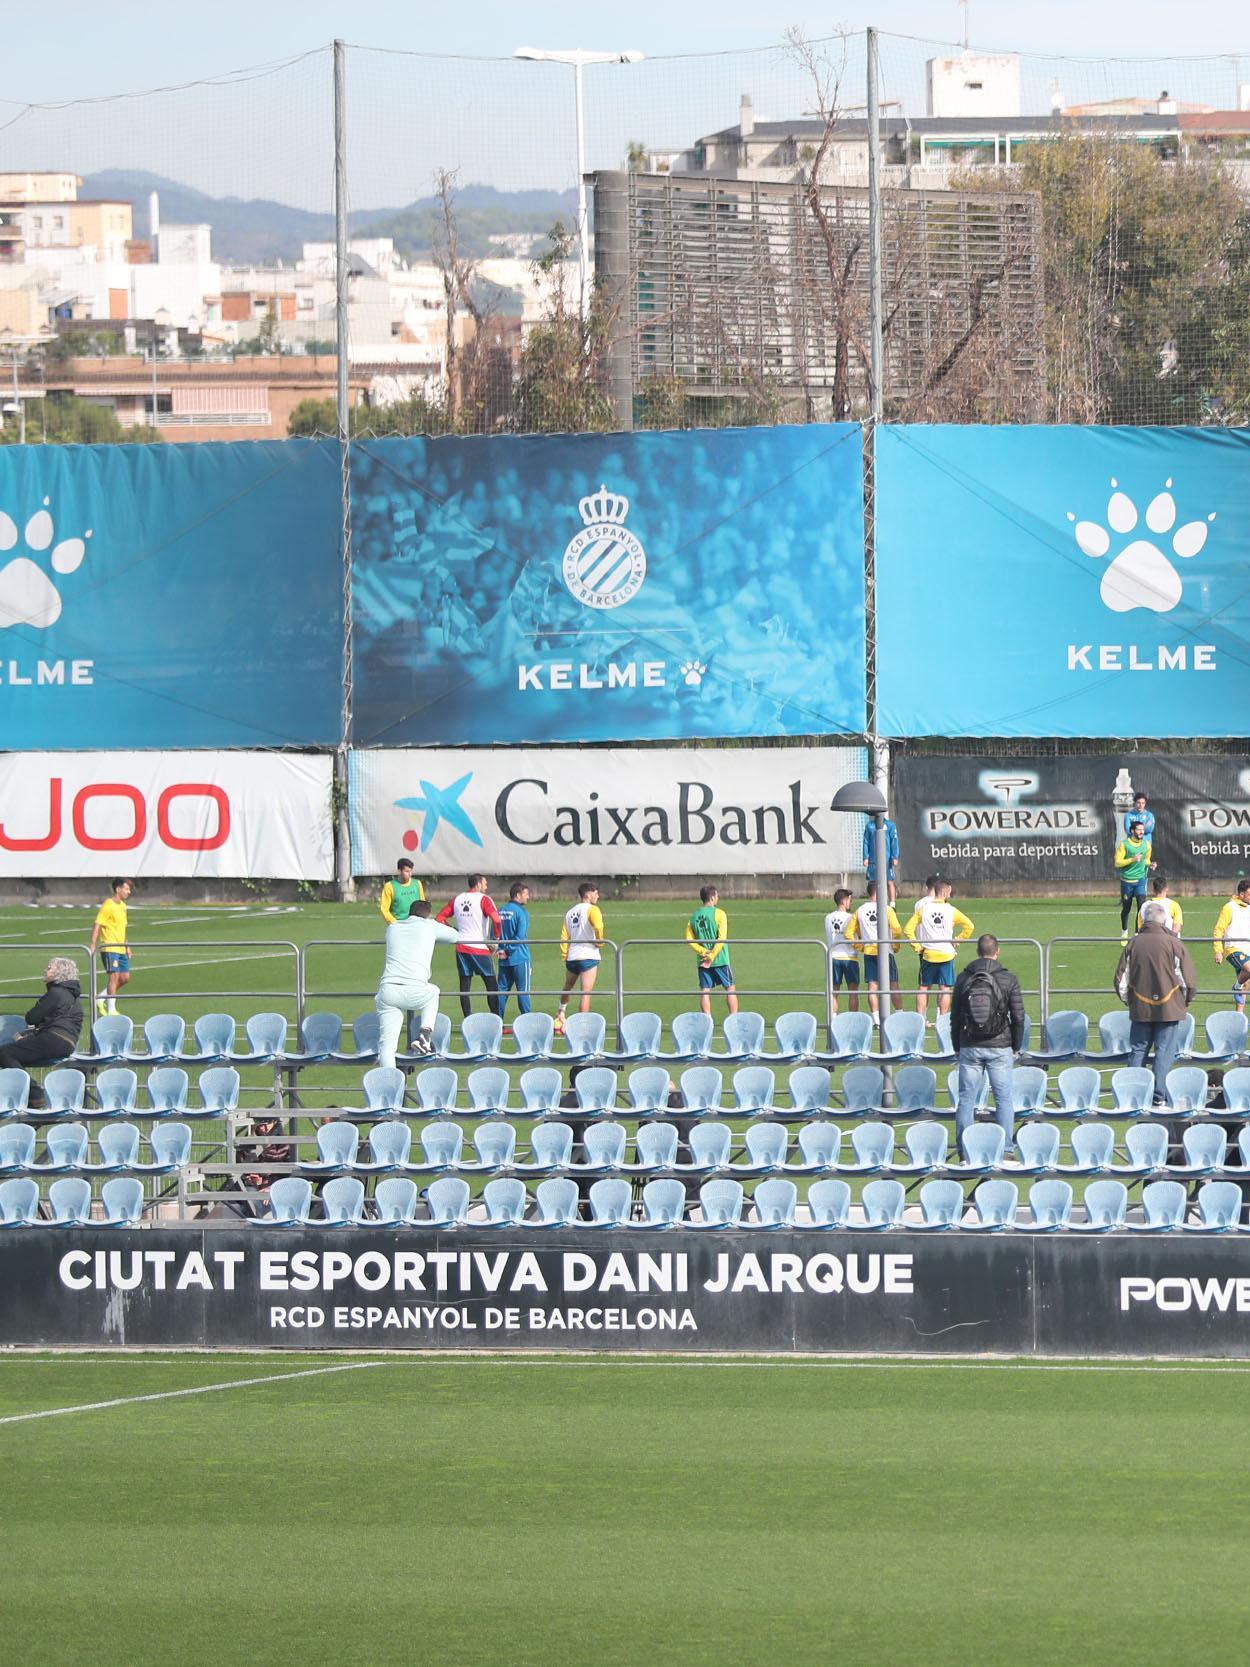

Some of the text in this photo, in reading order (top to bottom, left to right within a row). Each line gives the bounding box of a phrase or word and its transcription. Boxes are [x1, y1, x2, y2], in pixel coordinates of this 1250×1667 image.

[567, 527, 642, 562] RCD ESPANYOL
[579, 570, 643, 606] BARCELONA
[1067, 645, 1216, 671] KELME
[0, 660, 94, 685] LME
[518, 661, 666, 690] KELME
[495, 778, 826, 847] CaixaBank
[929, 810, 1088, 831] POWERADE
[931, 843, 1099, 861] bebida para deportistas
[1191, 841, 1240, 855] bebida
[58, 1250, 914, 1295] CIUTAT ESPORTIVA DANI JARQUE
[270, 1306, 698, 1330] RCD ESPANYOL DE BARCELONA
